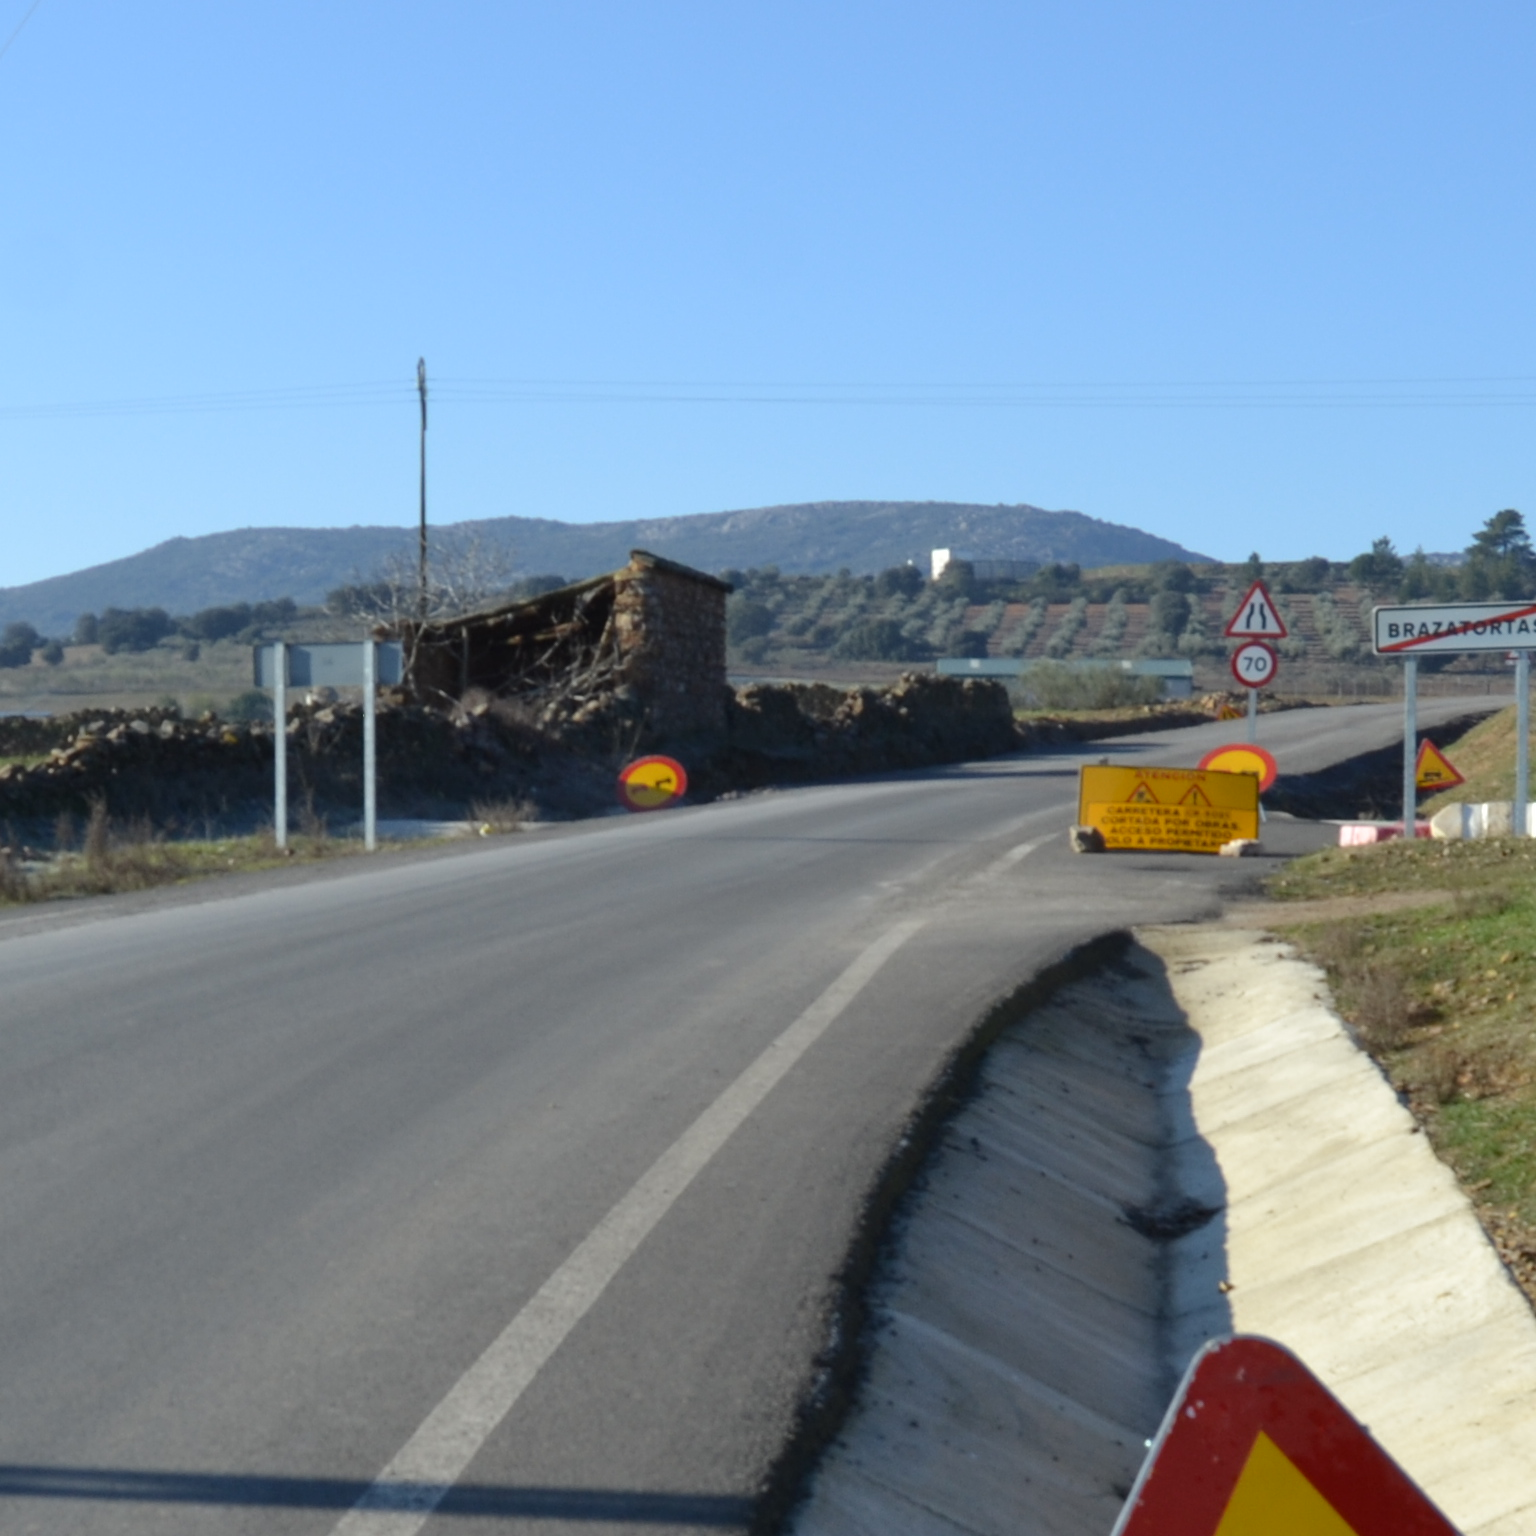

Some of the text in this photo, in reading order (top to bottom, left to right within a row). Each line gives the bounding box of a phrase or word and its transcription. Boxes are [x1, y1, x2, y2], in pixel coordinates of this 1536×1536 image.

[1243, 656, 1267, 671] 70
[1106, 806, 1180, 817] CARRETERA
[1101, 816, 1159, 826] CORTADA
[1165, 818, 1190, 827] POR
[1110, 826, 1233, 839] ACCESO PERMITIDO
[1105, 836, 1132, 845] OLO
